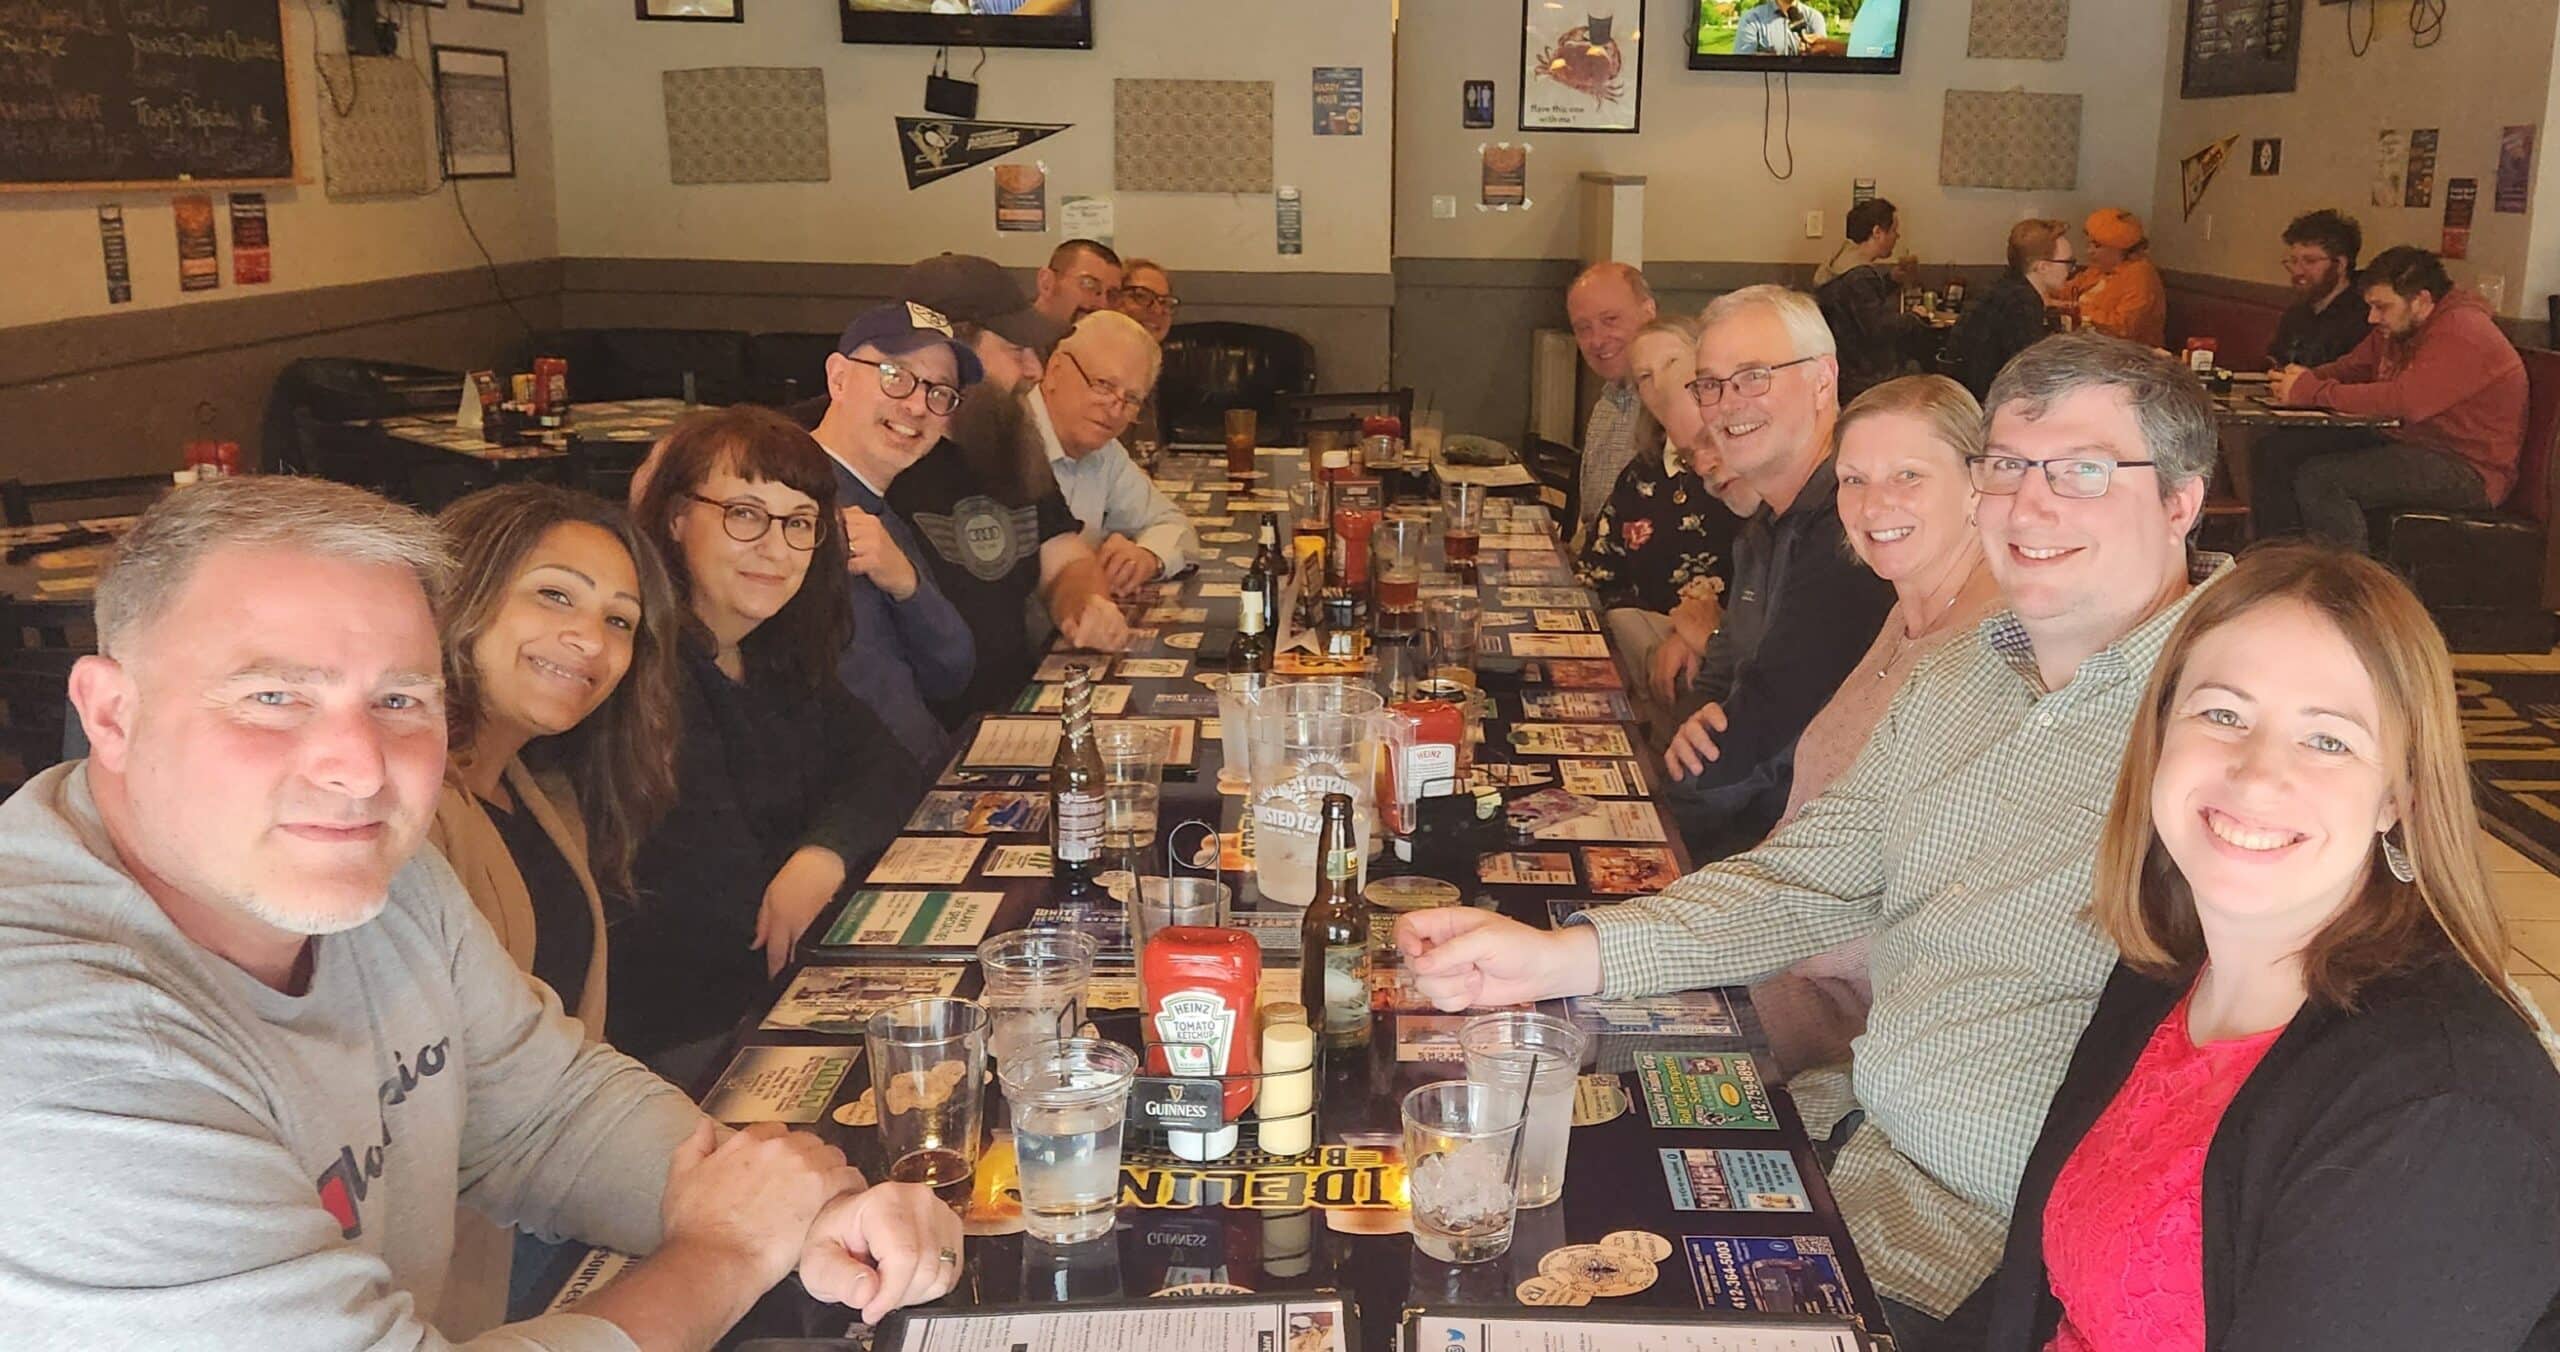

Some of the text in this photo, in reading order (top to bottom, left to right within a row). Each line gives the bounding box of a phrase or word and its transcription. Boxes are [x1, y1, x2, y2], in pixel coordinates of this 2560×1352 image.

[1416, 750, 1442, 759] HEINZ
[1174, 1002, 1211, 1016] HEINZ
[1173, 1021, 1216, 1032] TOMATO
[1176, 1031, 1215, 1041] KETCHUP
[1660, 1055, 1684, 1092] Dumpster
[1681, 1074, 1703, 1103] Service
[1732, 1059, 1772, 1121] 412-759-8894
[1145, 1101, 1208, 1117] GUINNESS
[1713, 1240, 1748, 1309] 412-364-5003
